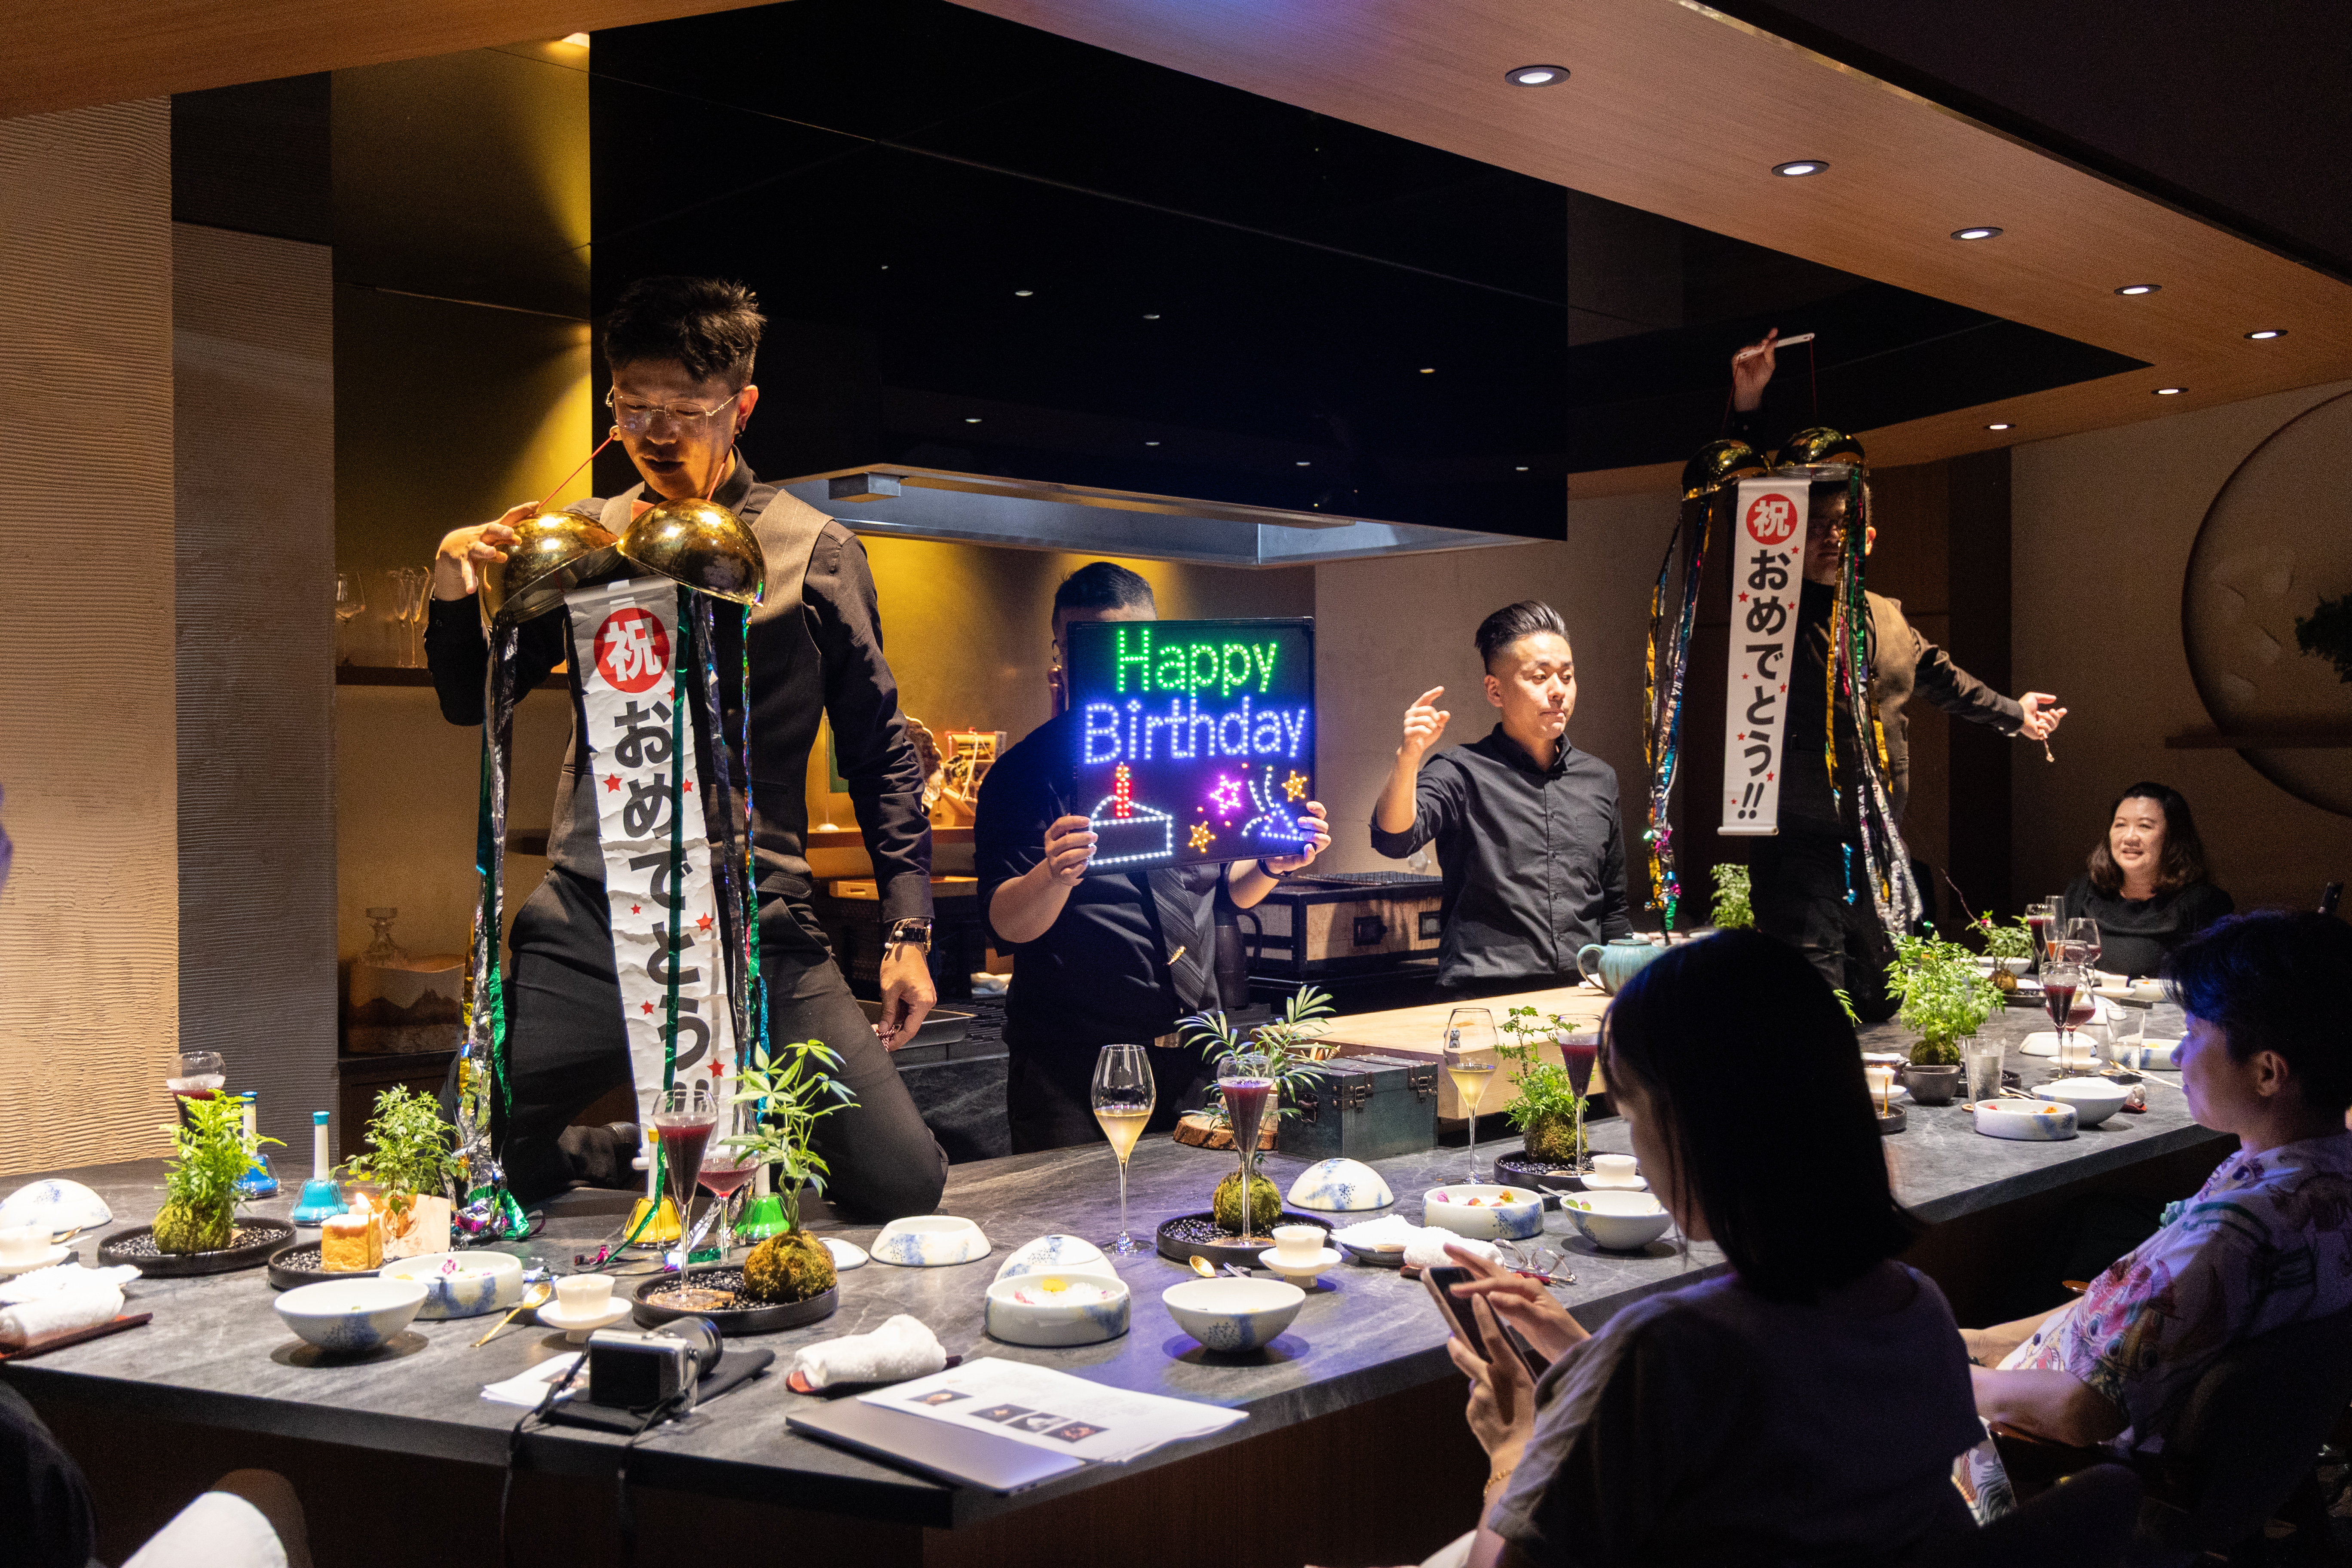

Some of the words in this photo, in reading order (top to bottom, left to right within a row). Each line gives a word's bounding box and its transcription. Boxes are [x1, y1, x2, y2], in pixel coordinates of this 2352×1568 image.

[1752, 499, 1790, 538] 祝
[604, 616, 663, 683] 祝
[1117, 629, 1277, 697] Happy
[1738, 549, 1792, 819] おめでとう!!
[1084, 695, 1306, 764] Birthday
